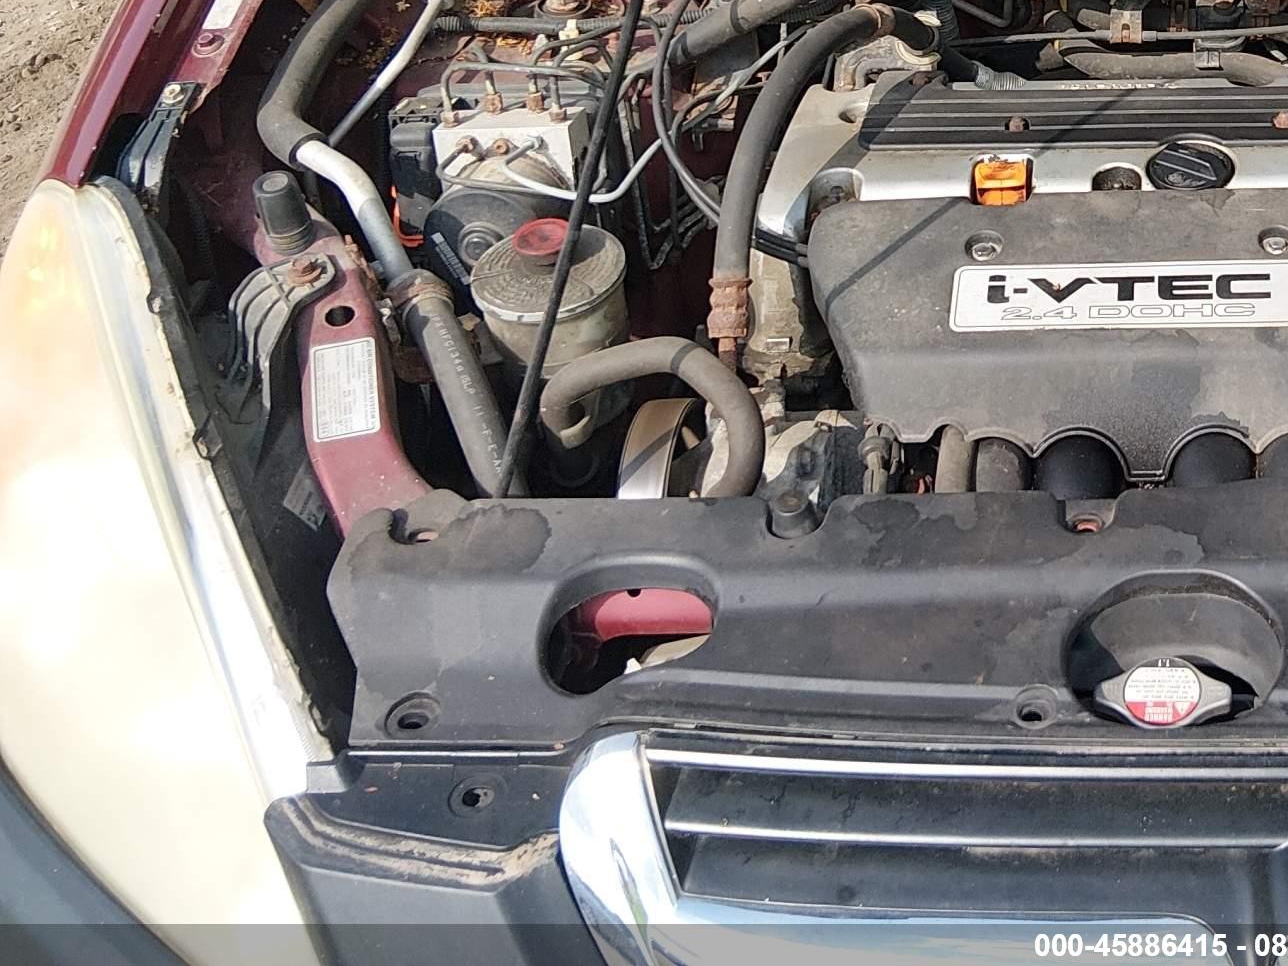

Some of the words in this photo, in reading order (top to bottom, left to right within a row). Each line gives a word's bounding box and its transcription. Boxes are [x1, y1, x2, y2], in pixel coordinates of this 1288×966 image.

[987, 273, 1271, 303] i-VTEC
[1001, 305, 1077, 321] 2.4
[1089, 303, 1256, 320] DOHC
